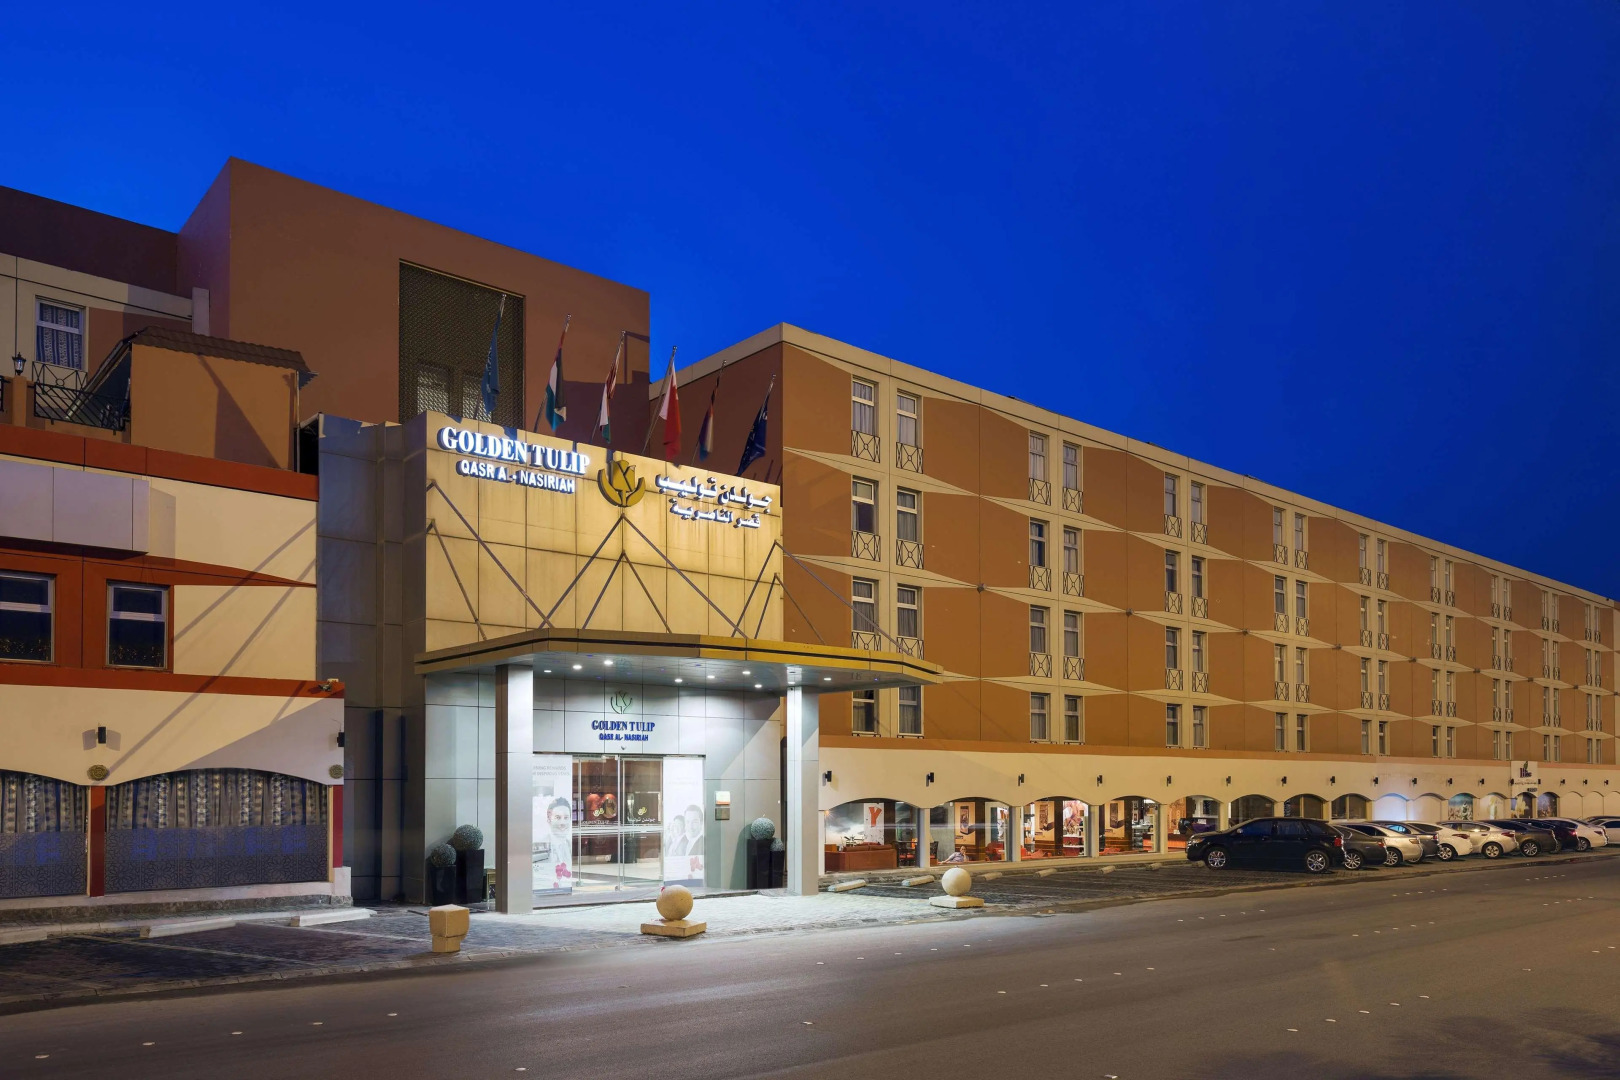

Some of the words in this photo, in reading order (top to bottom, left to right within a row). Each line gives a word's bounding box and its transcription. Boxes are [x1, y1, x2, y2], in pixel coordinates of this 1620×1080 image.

[440, 426, 527, 464] GOLDEN
[531, 443, 590, 475] TULIP
[458, 459, 495, 479] QASR
[518, 470, 576, 494] NASIRIAH
[656, 474, 717, 500] توليب
[669, 498, 733, 524] الناصرية
[718, 485, 773, 514] جولدن
[733, 513, 761, 529] قصر
[591, 719, 628, 731] GOLDEN
[628, 721, 656, 732] TULIP
[624, 733, 649, 742] NASIRIAH
